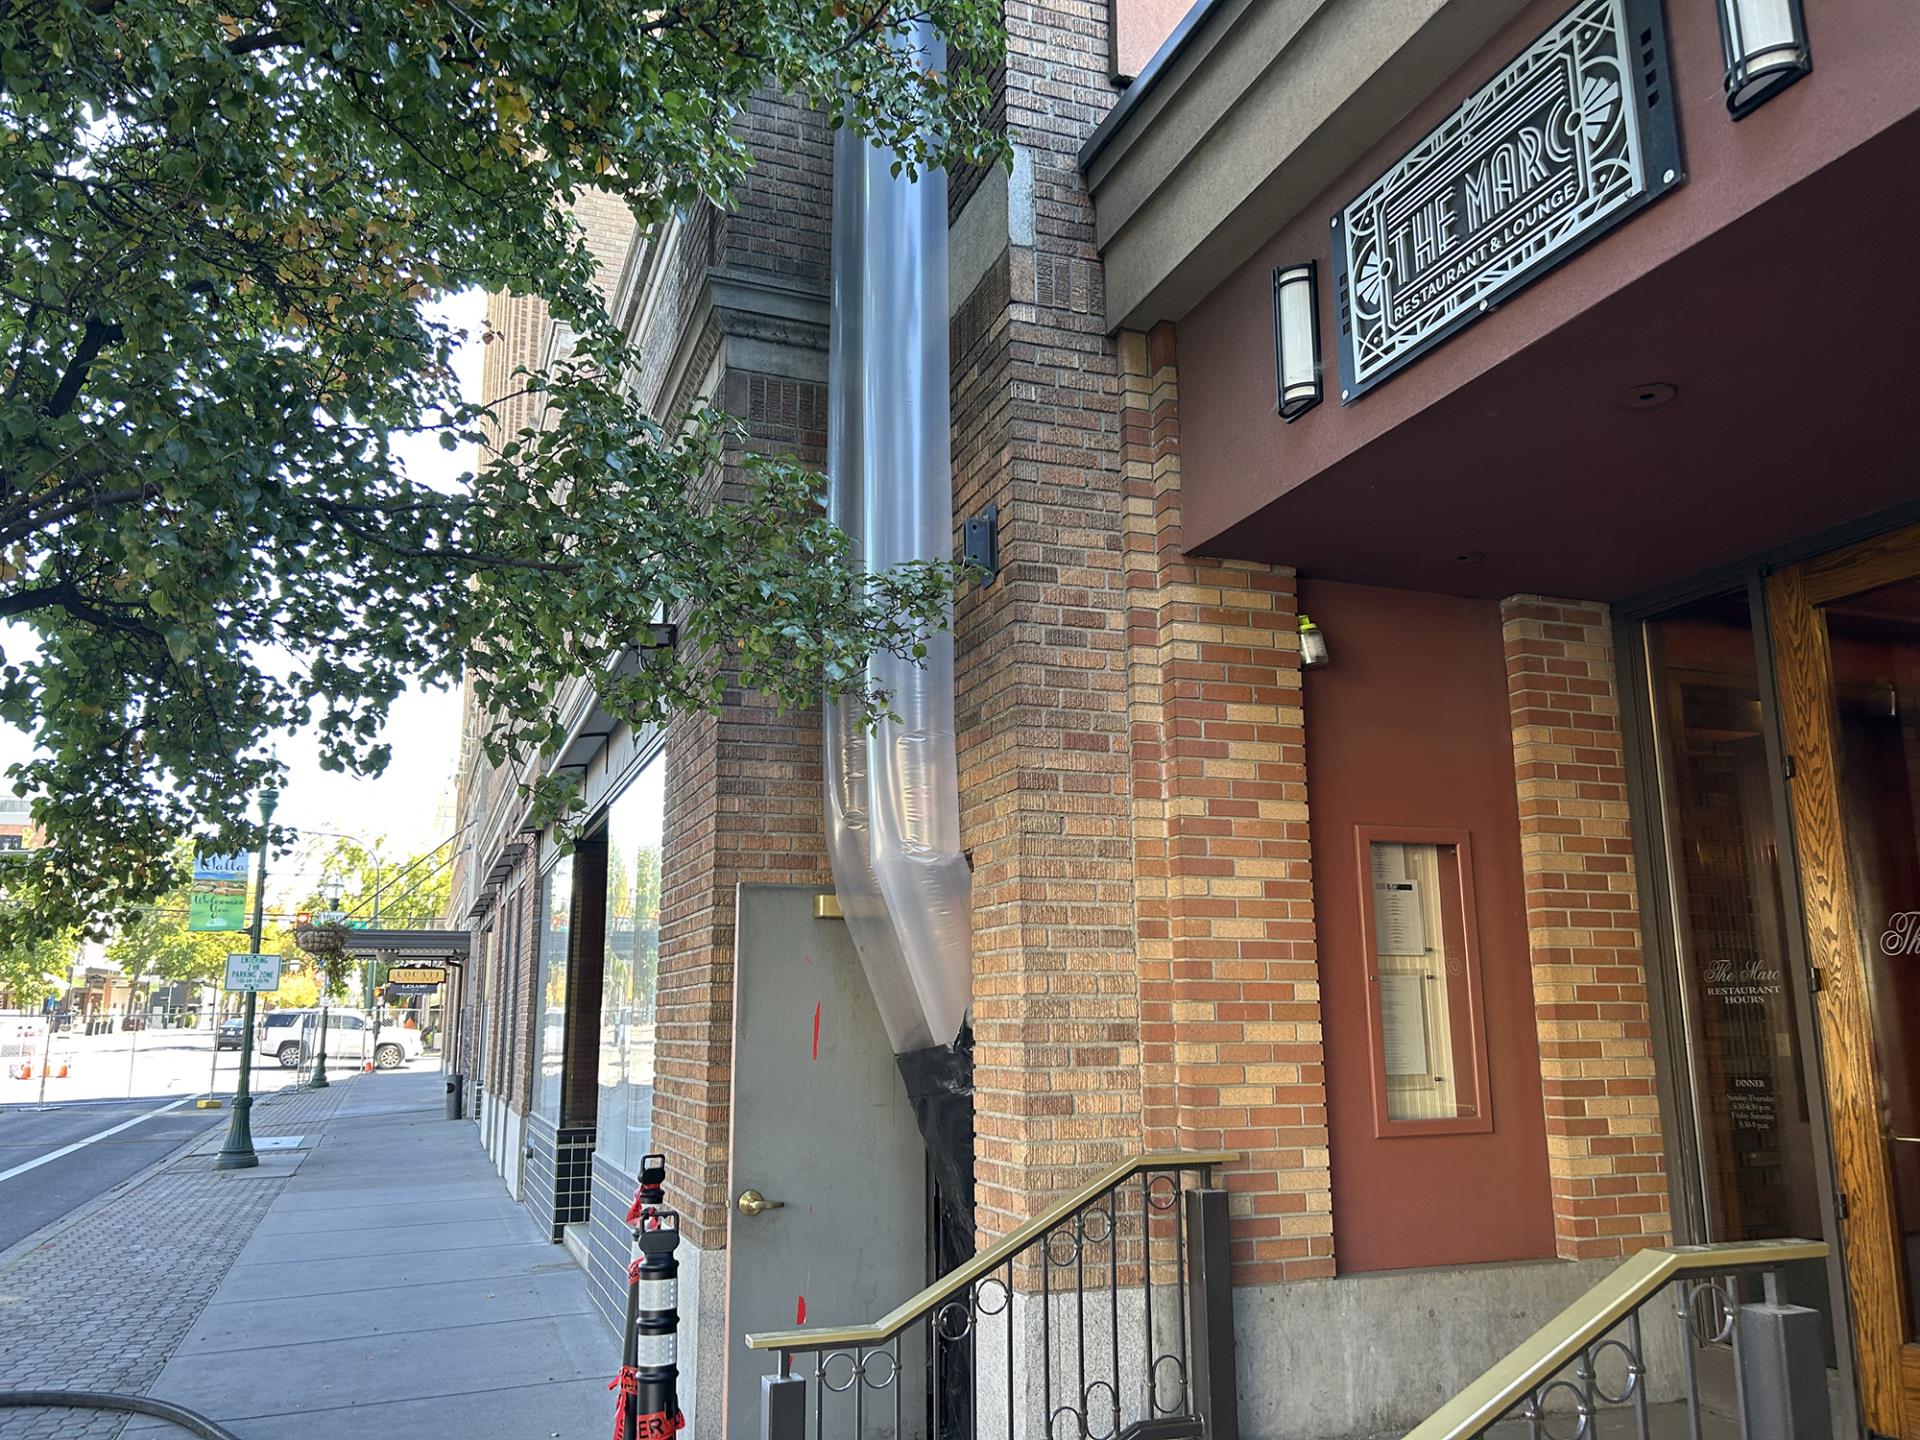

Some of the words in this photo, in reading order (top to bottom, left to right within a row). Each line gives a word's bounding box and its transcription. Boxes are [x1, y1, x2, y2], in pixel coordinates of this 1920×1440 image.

[1388, 186, 1459, 287] THE
[1464, 96, 1573, 234] MARC
[1394, 242, 1488, 323] RESTAURANT
[1490, 236, 1502, 254] &
[1503, 181, 1577, 243] LOUNGE
[209, 902, 230, 919] You
[240, 956, 268, 965] ENTERING
[231, 970, 257, 978] PARKING
[259, 971, 274, 979] ZONE
[1703, 959, 1736, 983] The
[1740, 959, 1781, 981] Marc
[1706, 985, 1781, 996] RESTAURANT
[1724, 995, 1765, 1005] HOURS
[1735, 1079, 1766, 1088] DINNER
